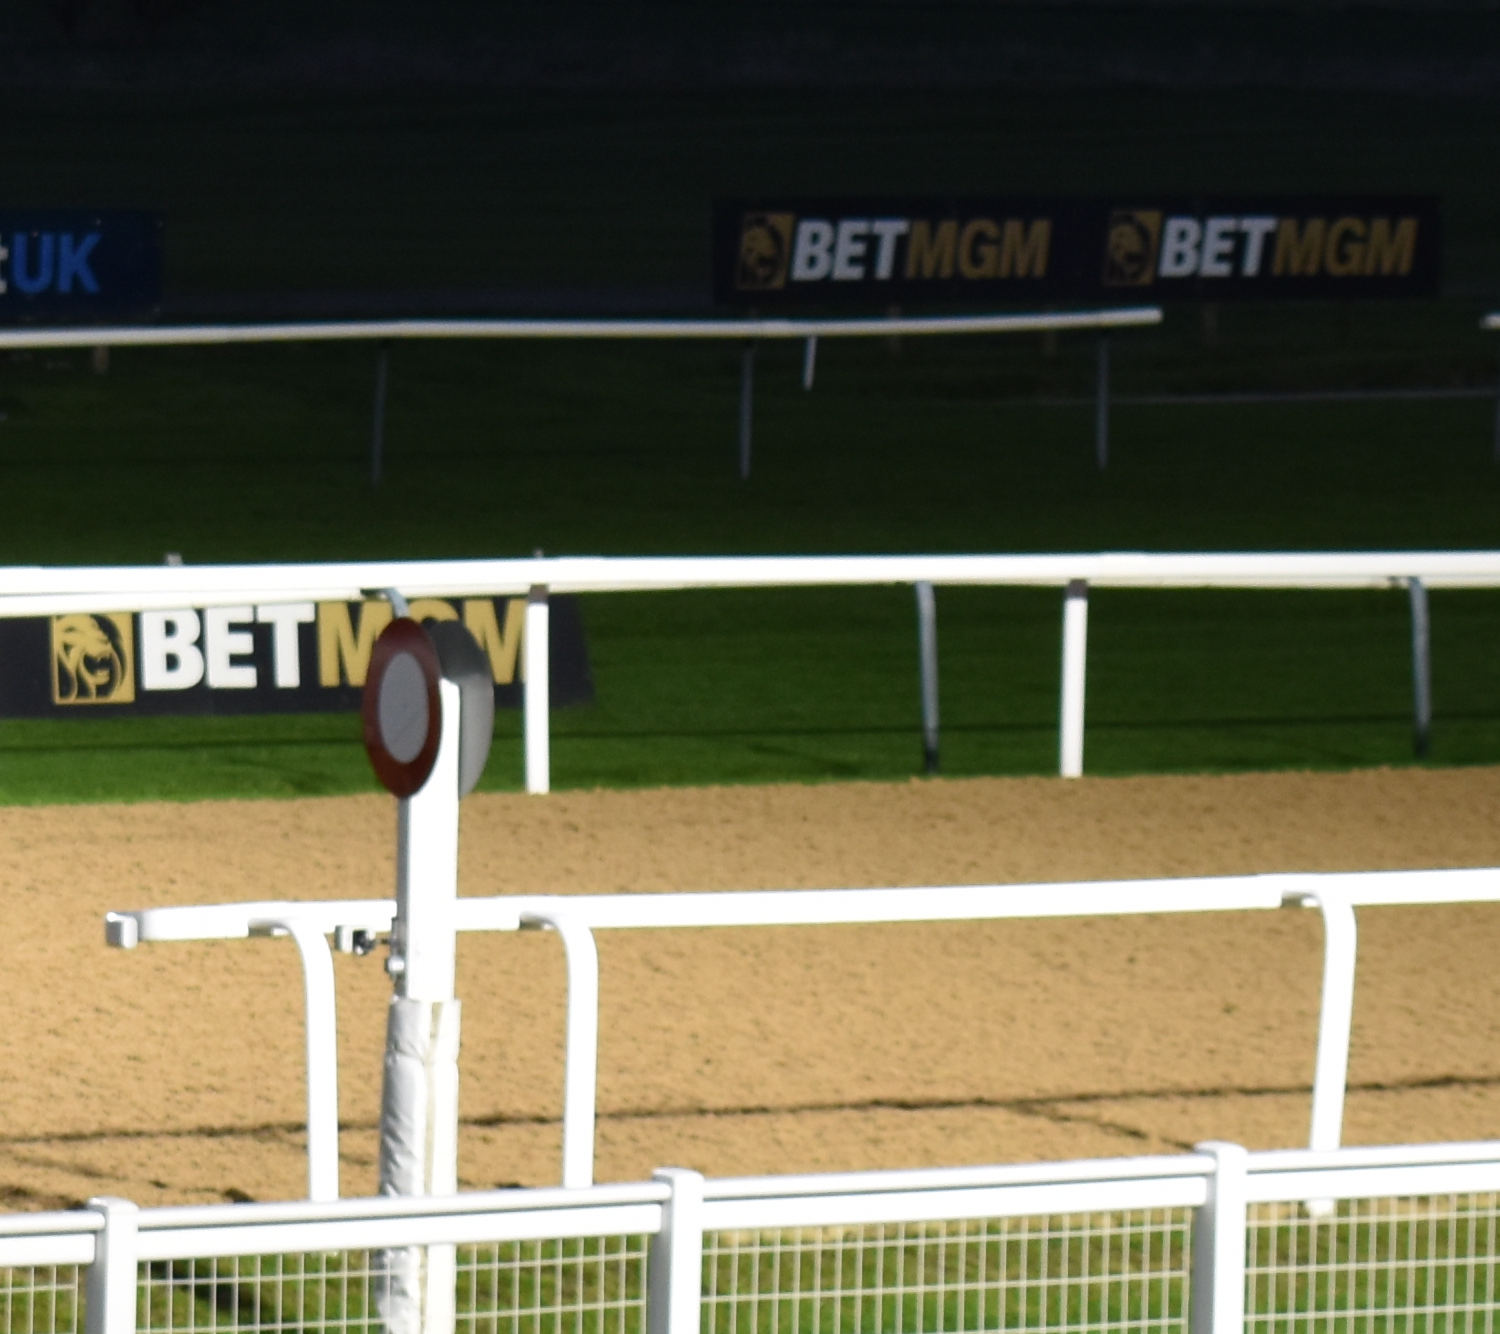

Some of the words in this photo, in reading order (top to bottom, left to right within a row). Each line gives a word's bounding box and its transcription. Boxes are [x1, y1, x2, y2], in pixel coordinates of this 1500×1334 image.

[792, 218, 1050, 280] BETMGM
[1159, 216, 1416, 278] BETMGM
[139, 598, 528, 691] BETMM
